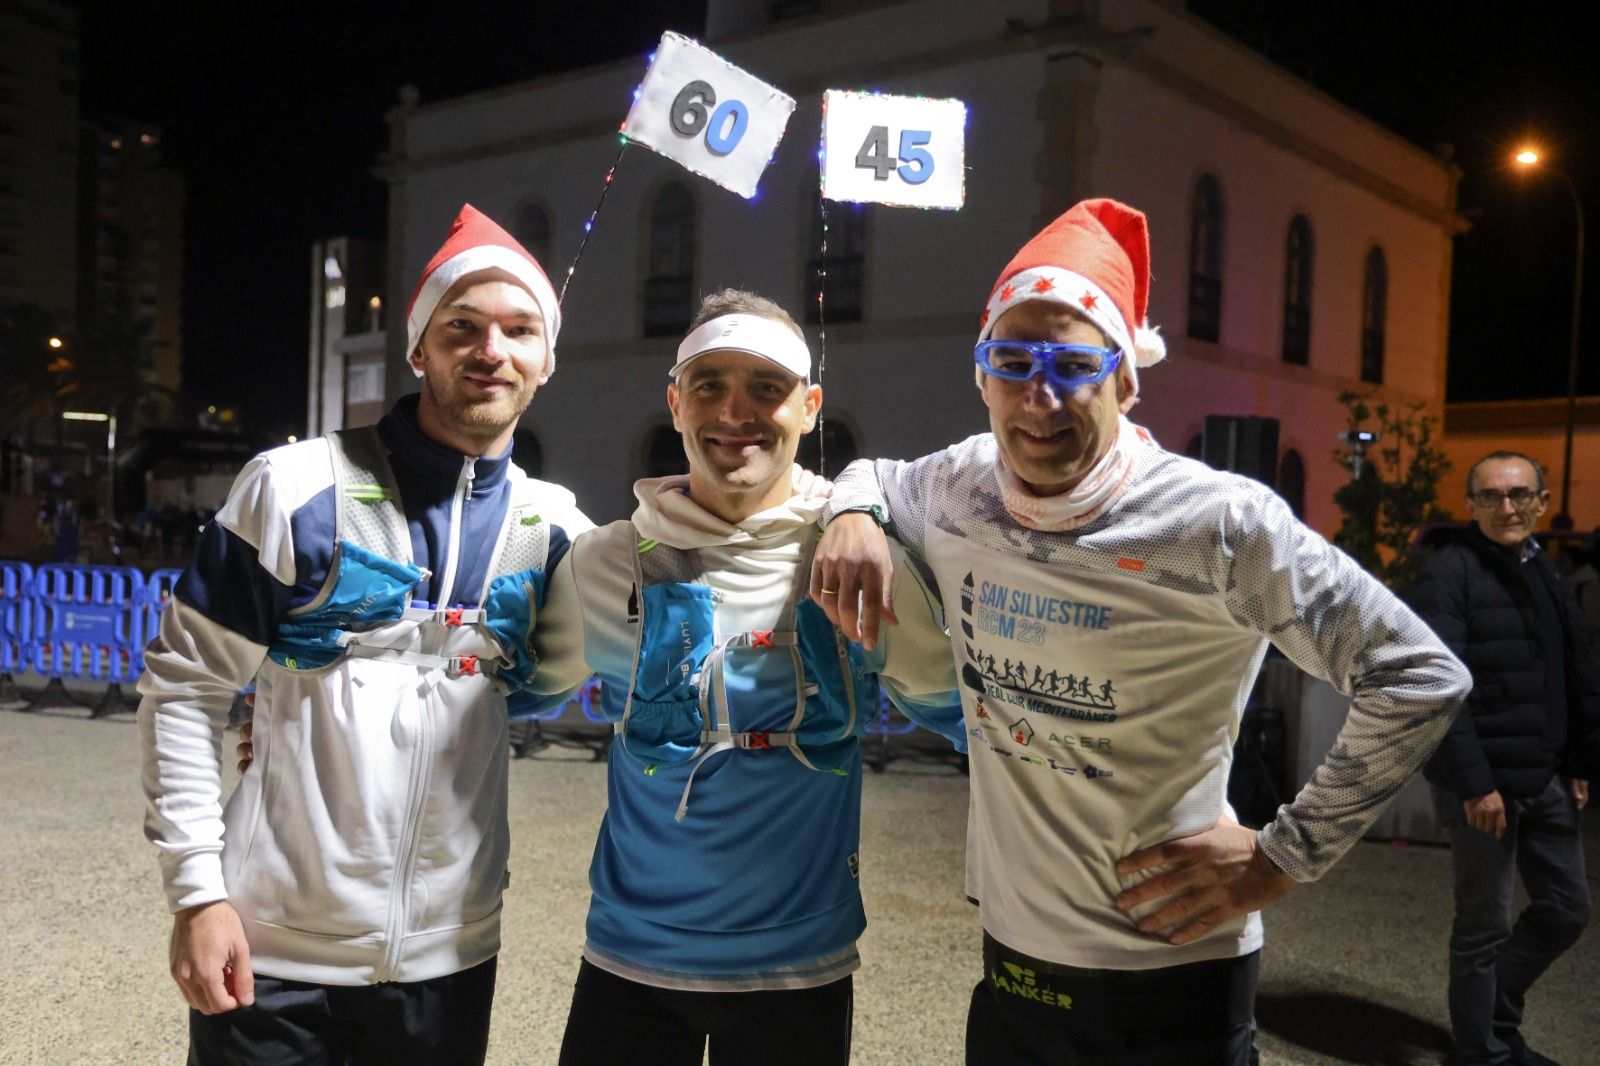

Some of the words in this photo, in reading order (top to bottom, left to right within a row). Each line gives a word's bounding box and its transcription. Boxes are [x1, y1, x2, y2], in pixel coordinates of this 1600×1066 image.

[669, 80, 749, 157] 60
[855, 125, 935, 185] 45
[977, 606, 1016, 640] RCM
[1017, 618, 1047, 647] 23
[979, 580, 1009, 611] SAN
[1009, 590, 1113, 631] SILVESTRE
